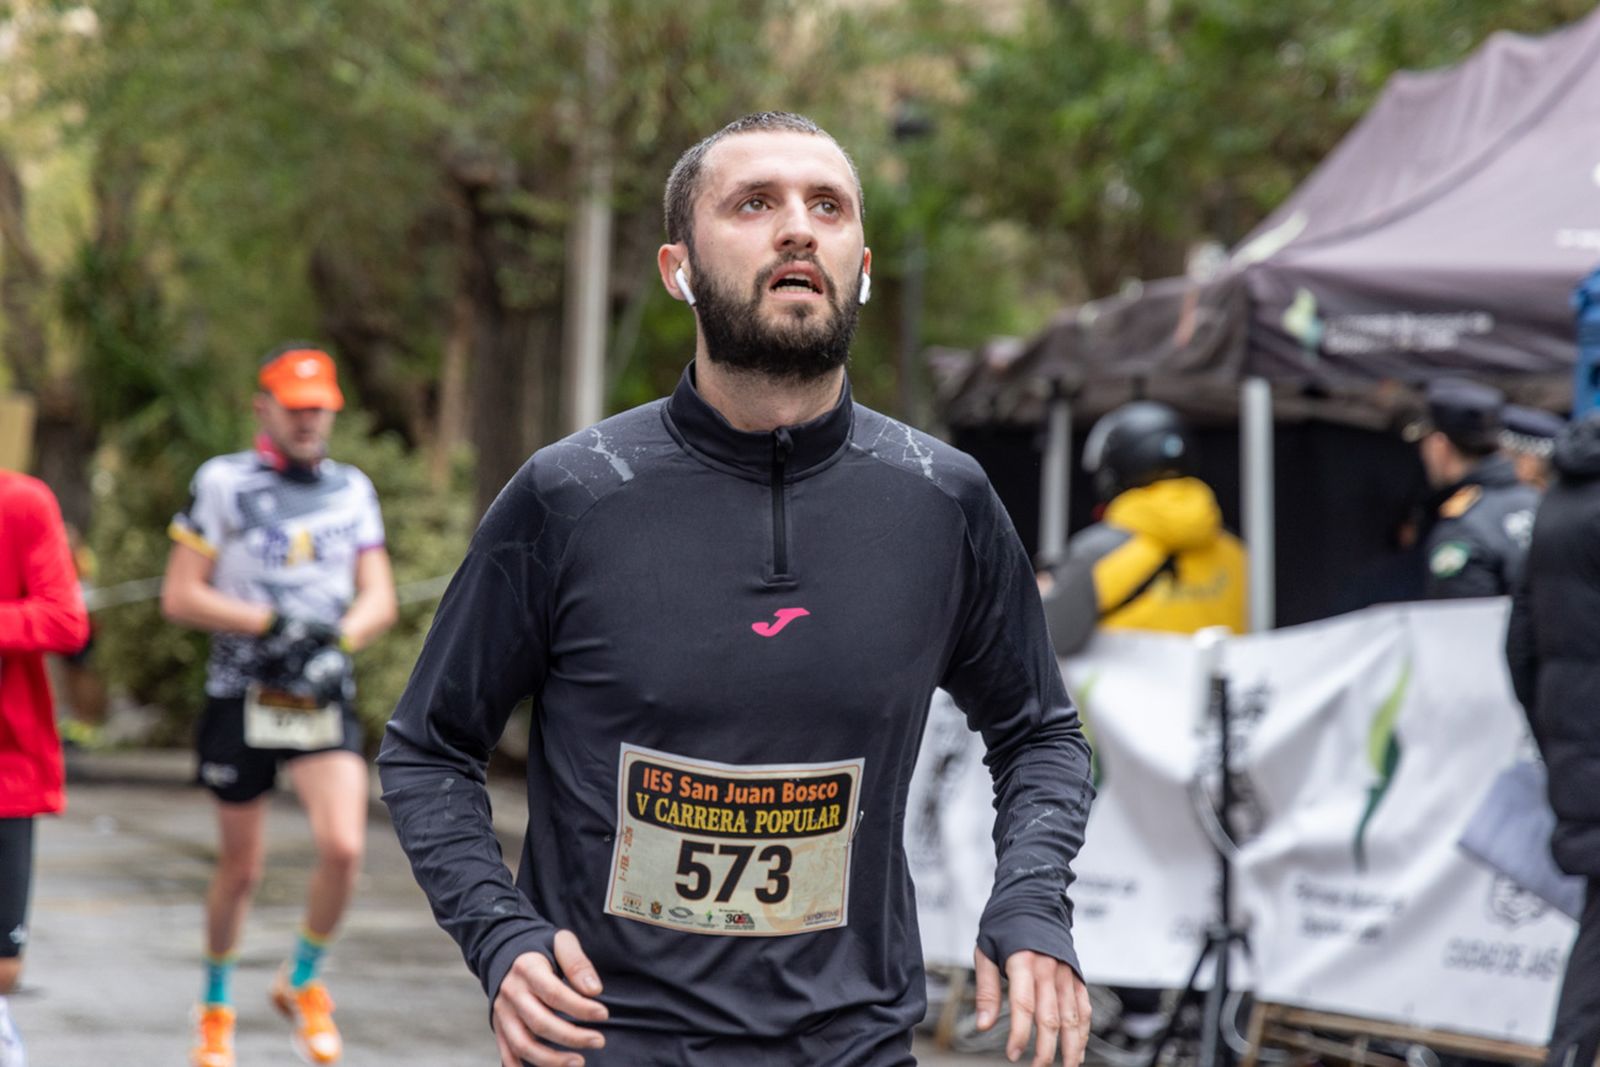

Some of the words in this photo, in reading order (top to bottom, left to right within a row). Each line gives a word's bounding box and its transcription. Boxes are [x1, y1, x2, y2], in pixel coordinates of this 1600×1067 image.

[642, 767, 673, 794] IES
[679, 775, 719, 802] San
[724, 782, 776, 804] Juan
[781, 781, 839, 803] Bosco
[635, 792, 650, 816] V
[654, 797, 748, 833] CARRERA
[753, 804, 841, 833] POPULAR
[675, 839, 793, 904] 573
